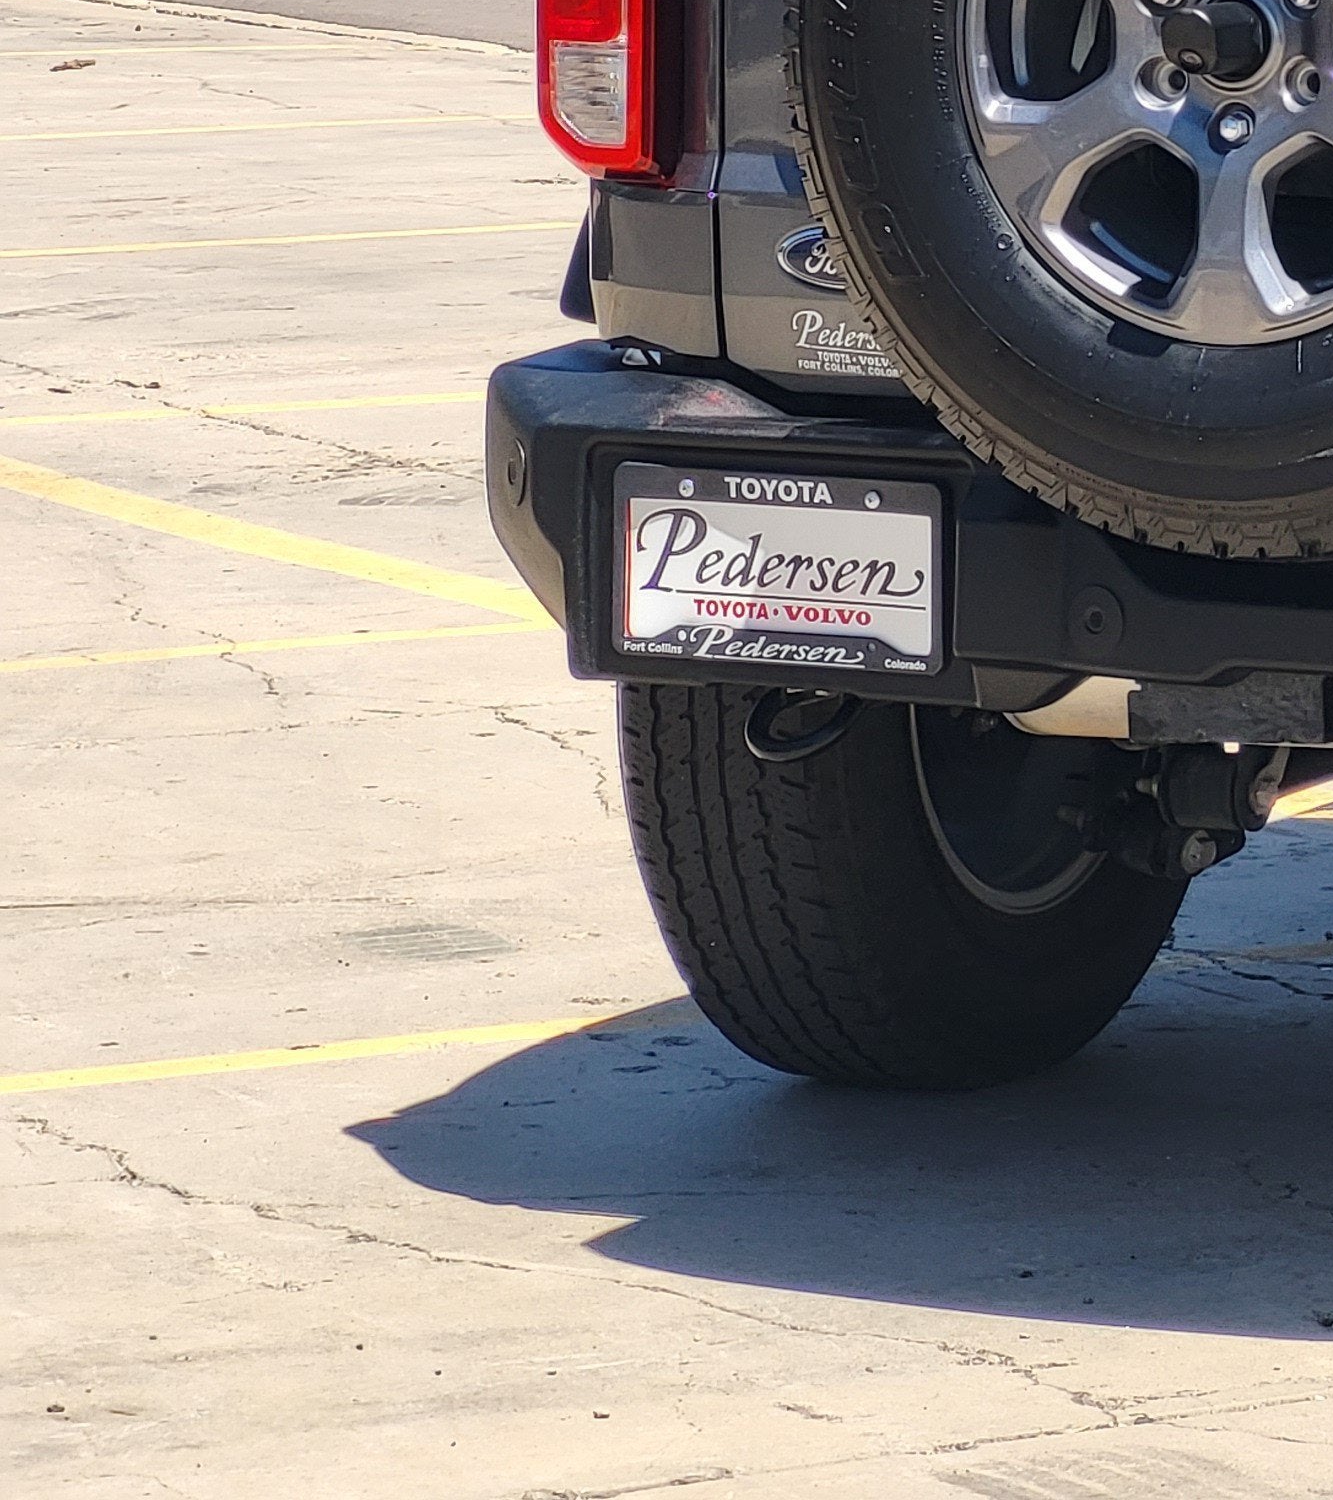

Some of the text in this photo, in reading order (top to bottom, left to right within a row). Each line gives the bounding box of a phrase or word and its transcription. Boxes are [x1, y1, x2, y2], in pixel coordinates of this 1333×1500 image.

[792, 310, 882, 349] Peders
[817, 351, 894, 367] TOYOTA VOLV
[868, 367, 902, 378] COLOR
[724, 476, 833, 505] TOYOTA
[636, 507, 925, 597] Pedersen
[694, 599, 872, 626] TOYOTA VOLVO
[623, 641, 683, 654] Fort Collins
[690, 624, 865, 663] Pedersen
[884, 658, 927, 671] Colorado
